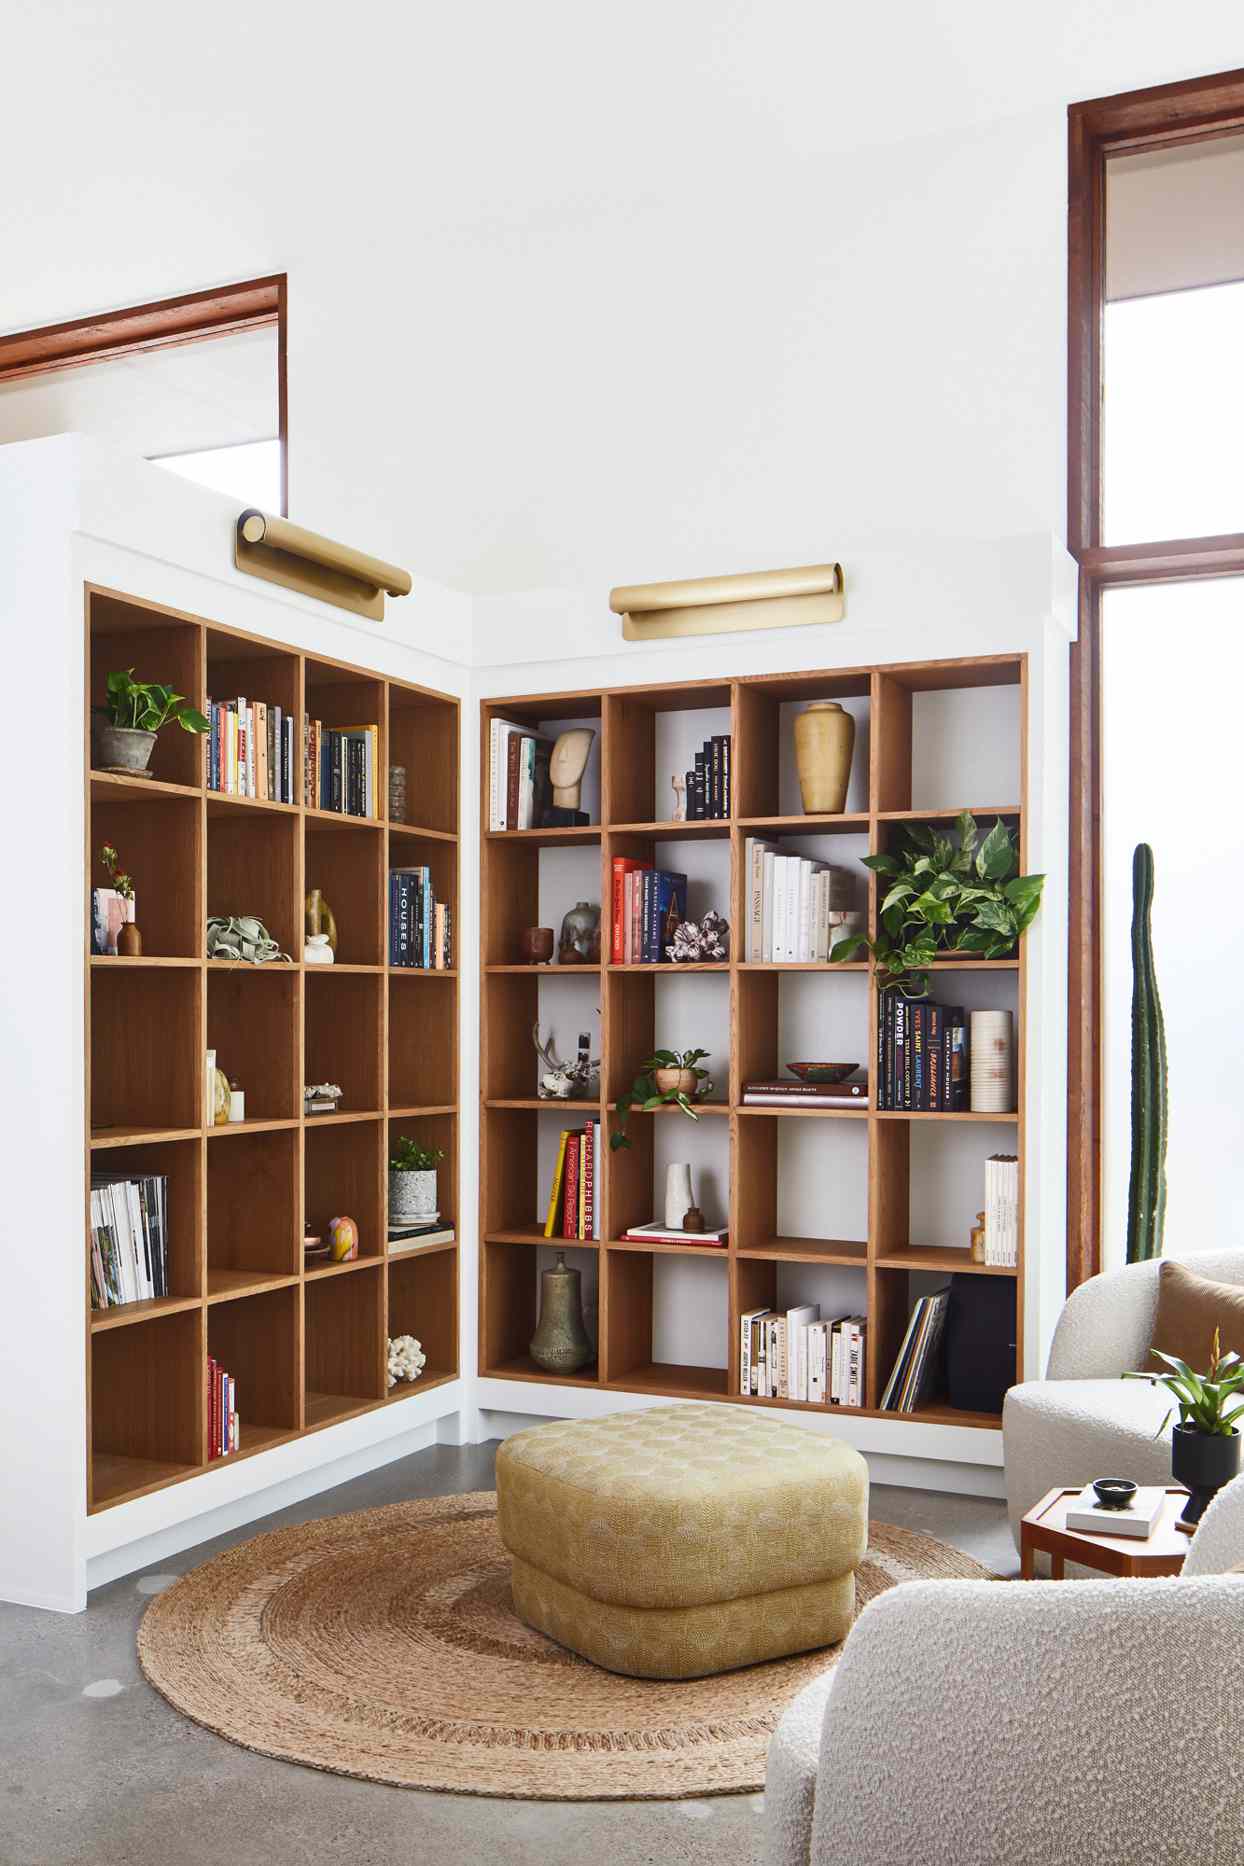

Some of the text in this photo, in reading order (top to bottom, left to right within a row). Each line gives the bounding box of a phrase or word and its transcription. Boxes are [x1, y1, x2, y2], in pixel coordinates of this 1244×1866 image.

[896, 1002, 904, 1046] POWDER
[914, 1030, 922, 1053] SAINT
[914, 1055, 922, 1089] LAURENT
[566, 1147, 577, 1224] American Ski Resort
[849, 1349, 858, 1385] ZADIE SMITH
